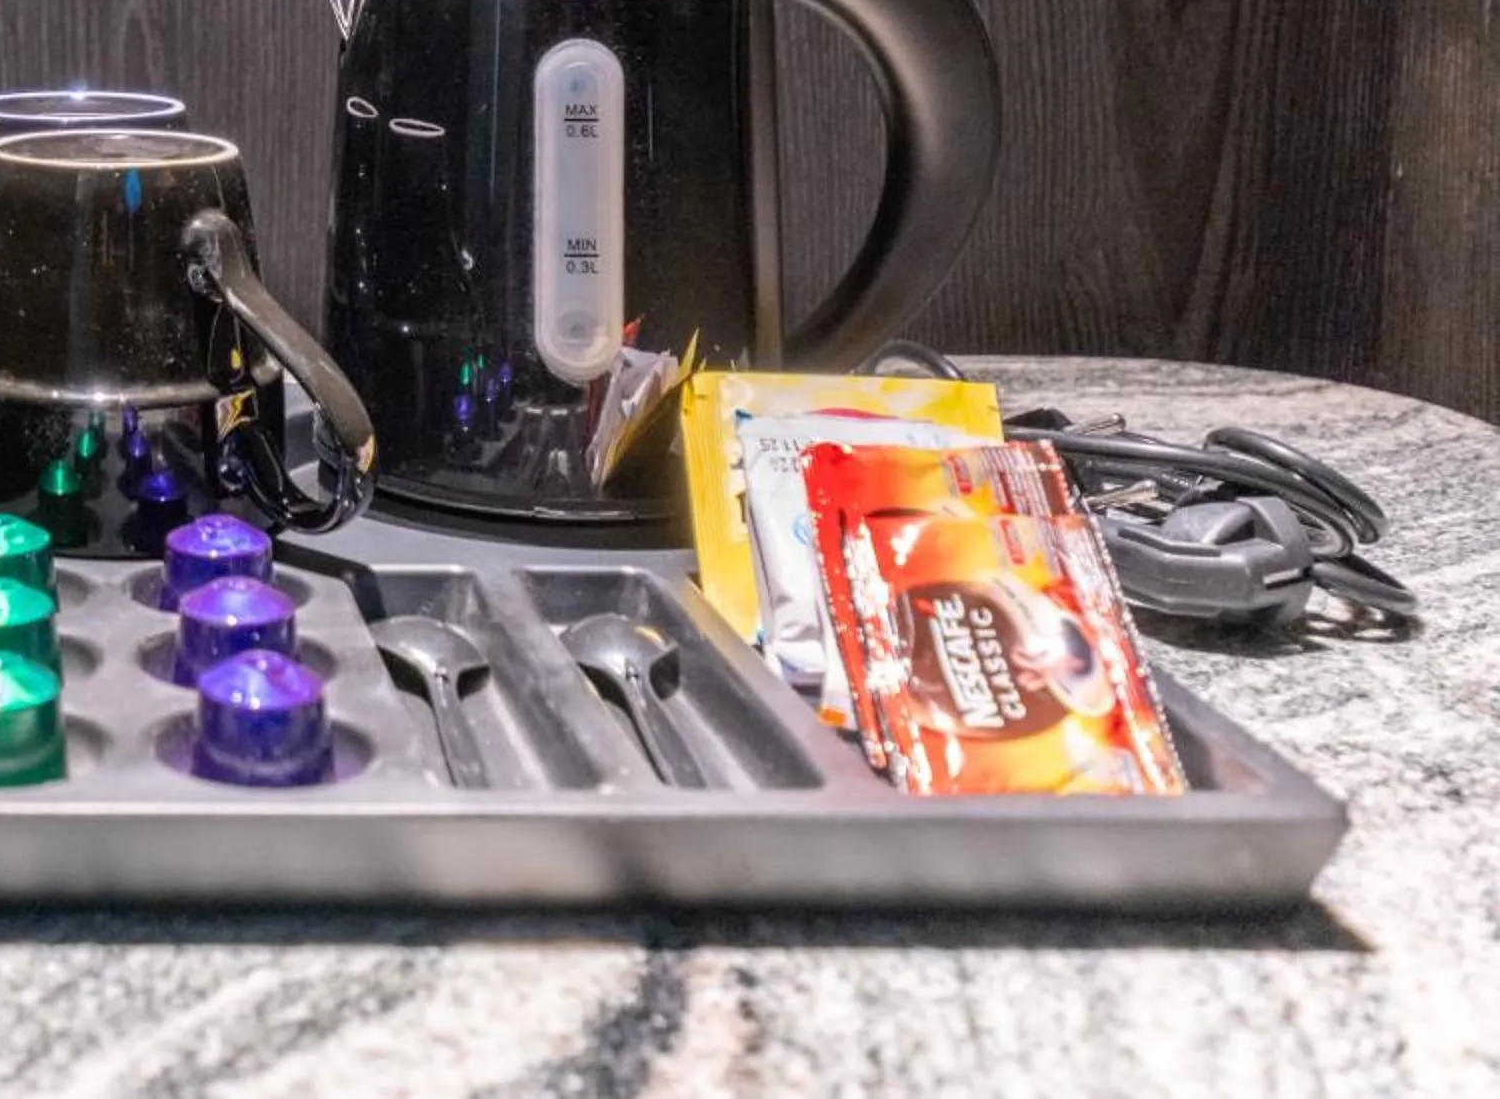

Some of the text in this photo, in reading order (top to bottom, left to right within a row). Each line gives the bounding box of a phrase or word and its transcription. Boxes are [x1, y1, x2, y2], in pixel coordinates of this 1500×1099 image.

[565, 104, 598, 116] MAX
[566, 124, 599, 138] 0.6L
[567, 238, 597, 251] MIN
[565, 260, 599, 274] 0.3L
[969, 606, 1027, 720] CLASSIC
